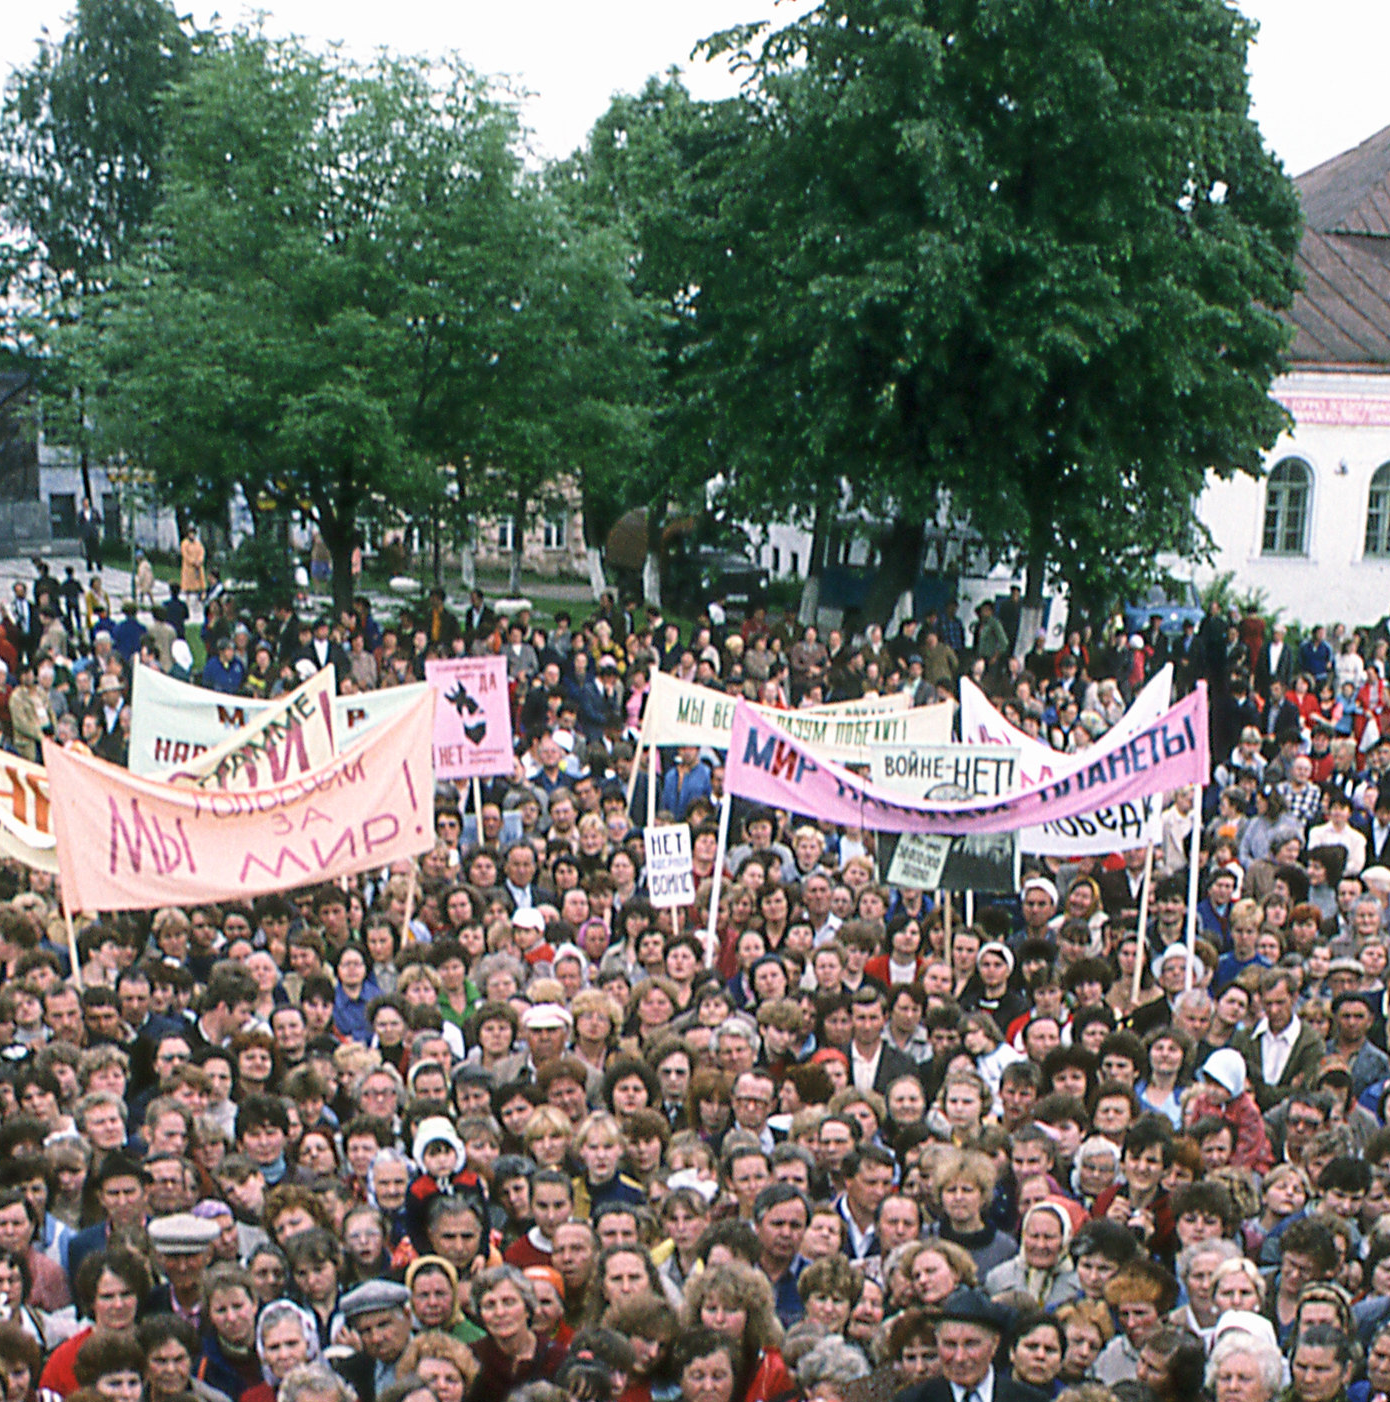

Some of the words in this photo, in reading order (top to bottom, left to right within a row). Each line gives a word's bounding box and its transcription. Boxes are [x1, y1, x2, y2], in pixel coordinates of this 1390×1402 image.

[478, 671, 498, 695] ДА
[676, 695, 707, 727] МЫ
[438, 745, 464, 767] НЕТ
[742, 726, 818, 785] МИР
[107, 795, 197, 875] МЫ
[268, 806, 333, 836] ЗА
[650, 831, 683, 856] НЕТ
